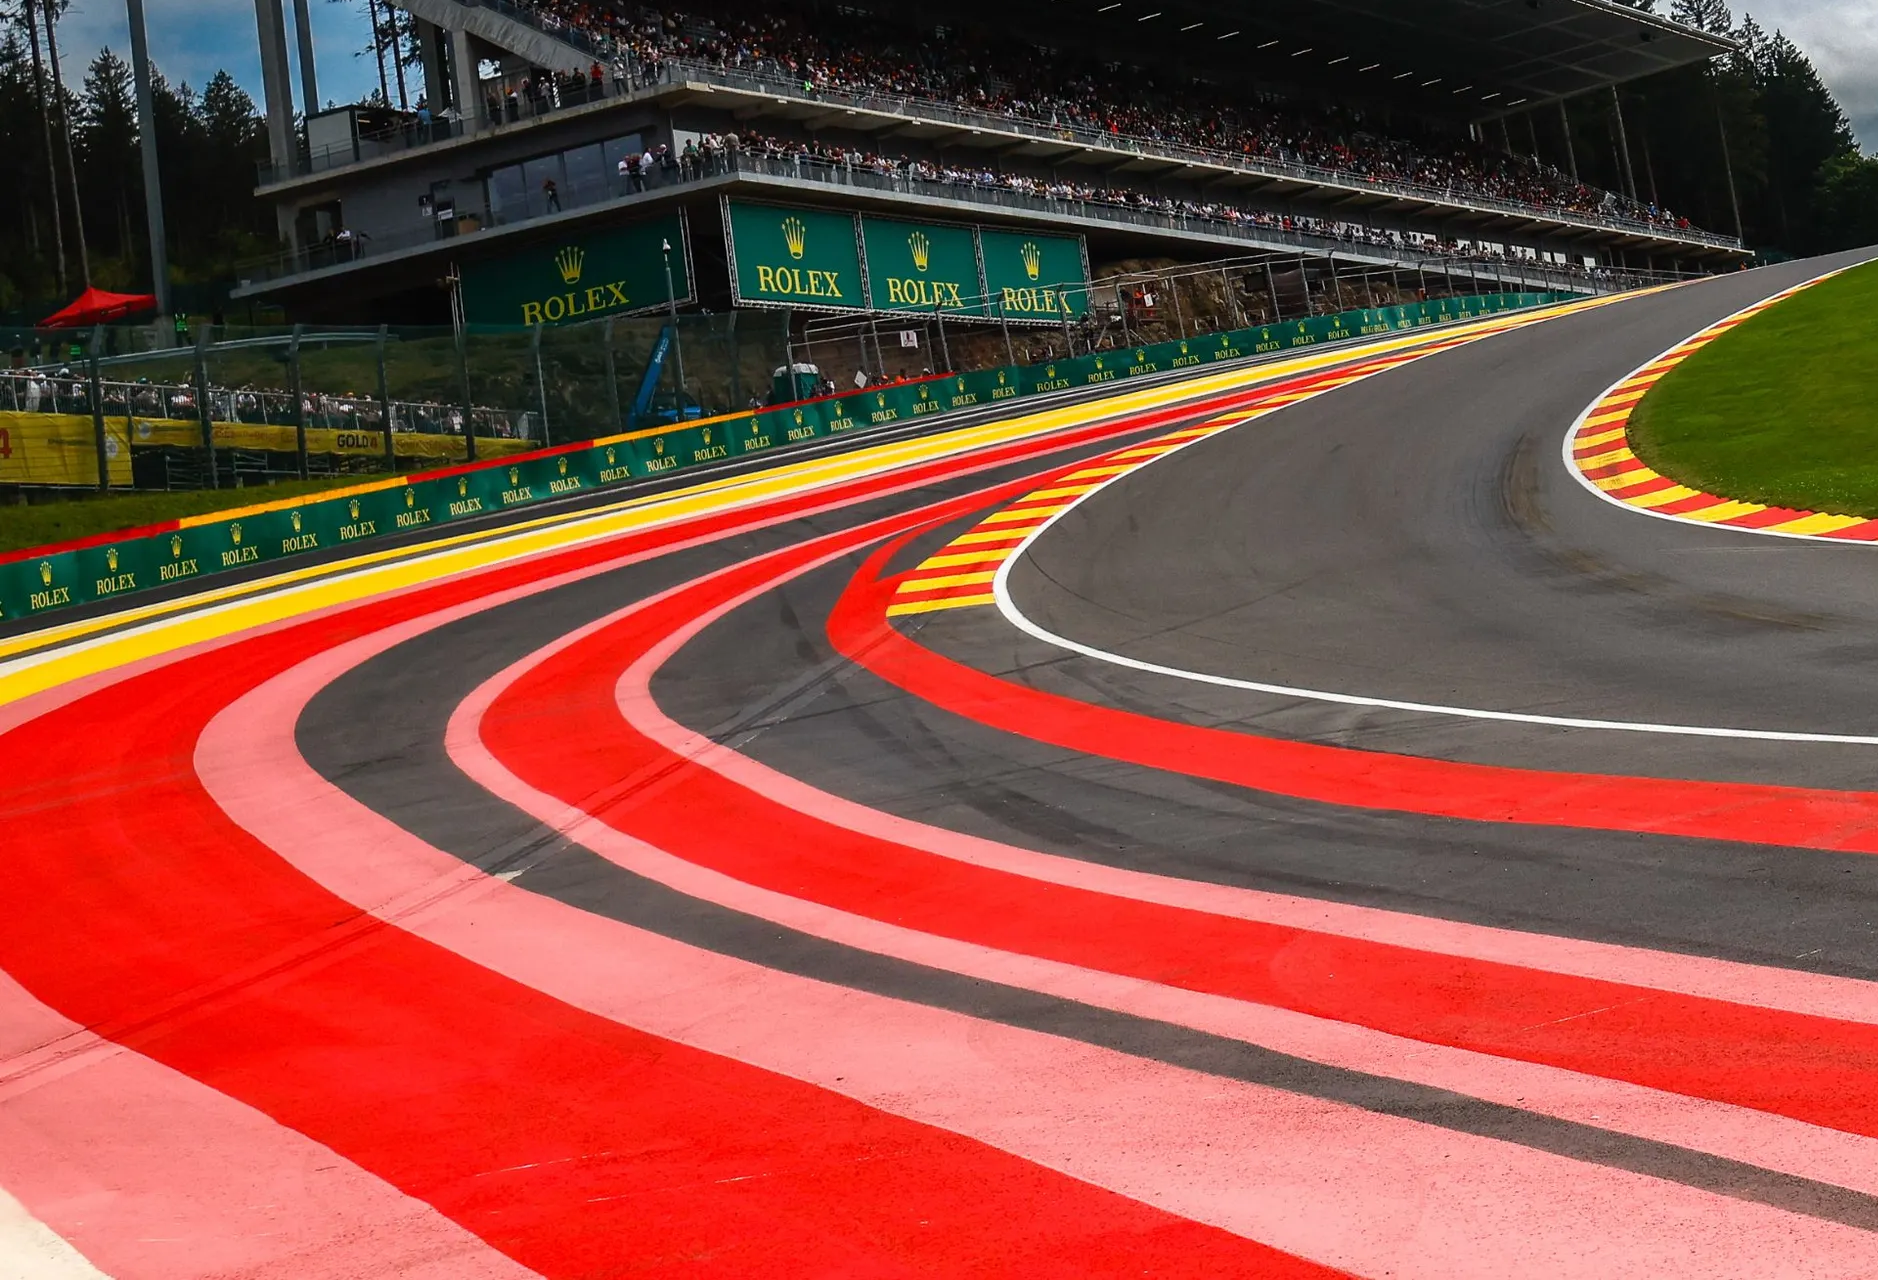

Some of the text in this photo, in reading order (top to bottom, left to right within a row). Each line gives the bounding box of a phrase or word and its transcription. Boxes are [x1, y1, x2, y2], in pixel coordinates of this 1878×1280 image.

[757, 265, 842, 298] ROLEX
[888, 277, 964, 309] ROLEX
[1003, 287, 1072, 314] ROLEX
[521, 280, 629, 326] ROLEX
[1292, 334, 1315, 346] ROLEX
[1328, 329, 1350, 340] ROLEX
[1214, 348, 1240, 360] ROLEX
[1256, 340, 1280, 352] ROLEX
[1130, 363, 1157, 375] ROLEX
[1172, 355, 1200, 368] ROLEX
[1088, 370, 1114, 382] ROLEX
[992, 386, 1015, 399] ROLEX
[1036, 378, 1070, 392] ROLEX
[913, 401, 939, 415] ROLEX
[952, 394, 977, 407] ROLEX
[872, 408, 897, 422] ROLEX
[830, 418, 854, 431] ROLEX
[336, 434, 368, 449] GOLD
[788, 426, 814, 441] ROLEX
[744, 436, 770, 451] ROLEX
[695, 445, 726, 461] ROLEX
[646, 456, 676, 472] ROLEX
[600, 466, 630, 482] ROLEX
[550, 476, 580, 493] ROLEX
[502, 487, 532, 504] ROLEX
[450, 498, 482, 515] ROLEX
[396, 509, 430, 527] ROLEX
[340, 521, 376, 540] ROLEX
[282, 534, 318, 552] ROLEX
[222, 546, 258, 567] ROLEX
[160, 559, 198, 580] ROLEX
[97, 573, 136, 595] ROLEX
[31, 587, 70, 609] ROLEX
